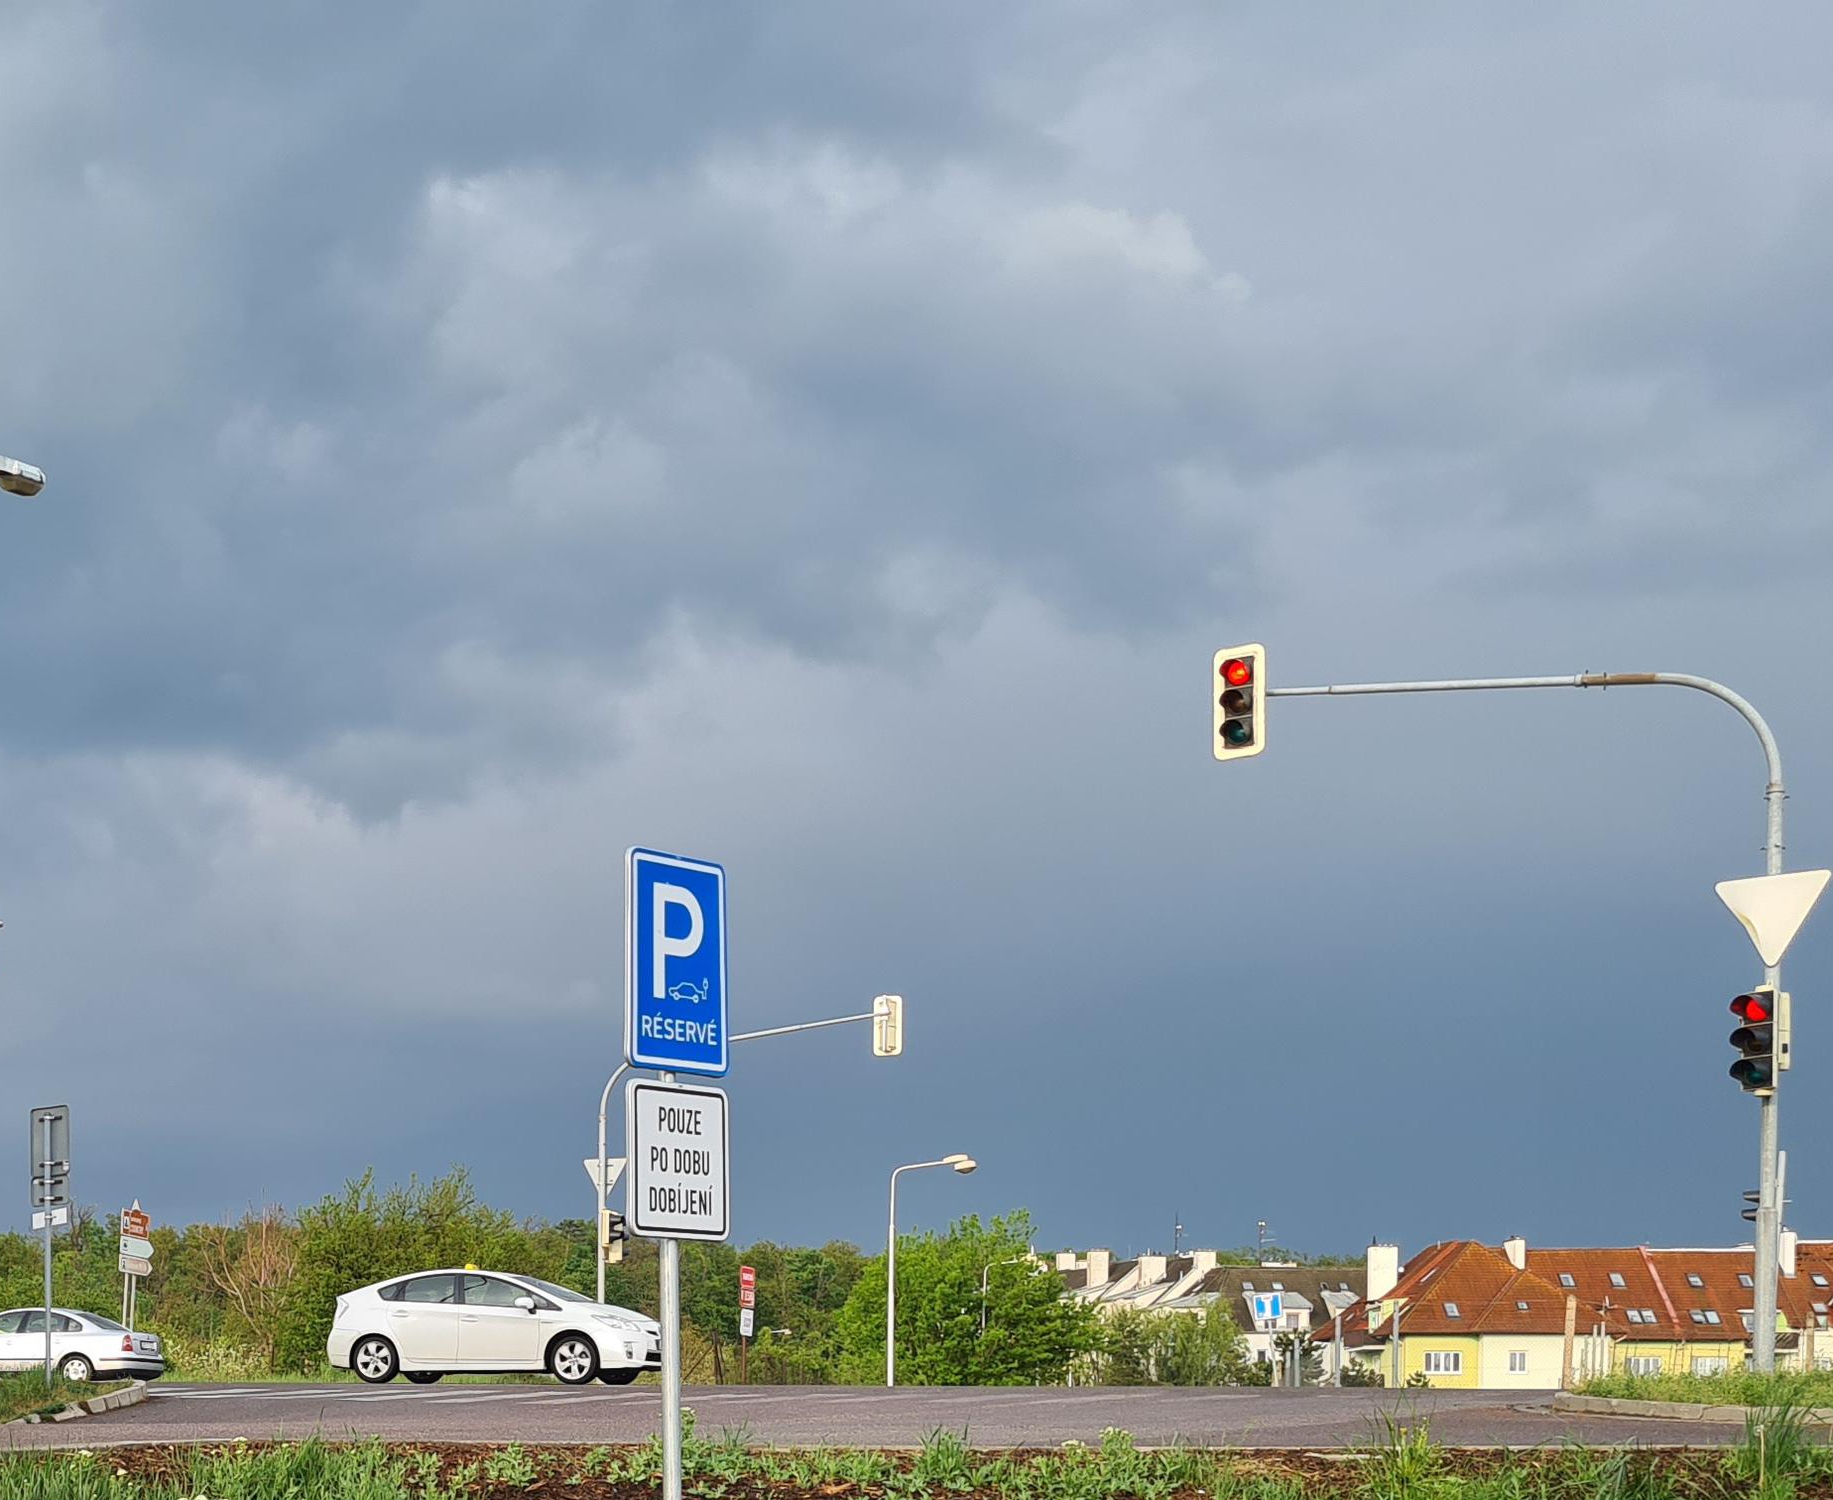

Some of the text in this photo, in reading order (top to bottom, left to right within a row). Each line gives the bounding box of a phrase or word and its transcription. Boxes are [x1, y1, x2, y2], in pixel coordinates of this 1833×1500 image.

[652, 881, 705, 1000] P
[641, 1011, 718, 1046] RÉSERVÉ
[657, 1105, 702, 1136] POUZE
[650, 1146, 710, 1177] PO DOBU
[649, 1184, 713, 1217] DOBÍJENÍ
